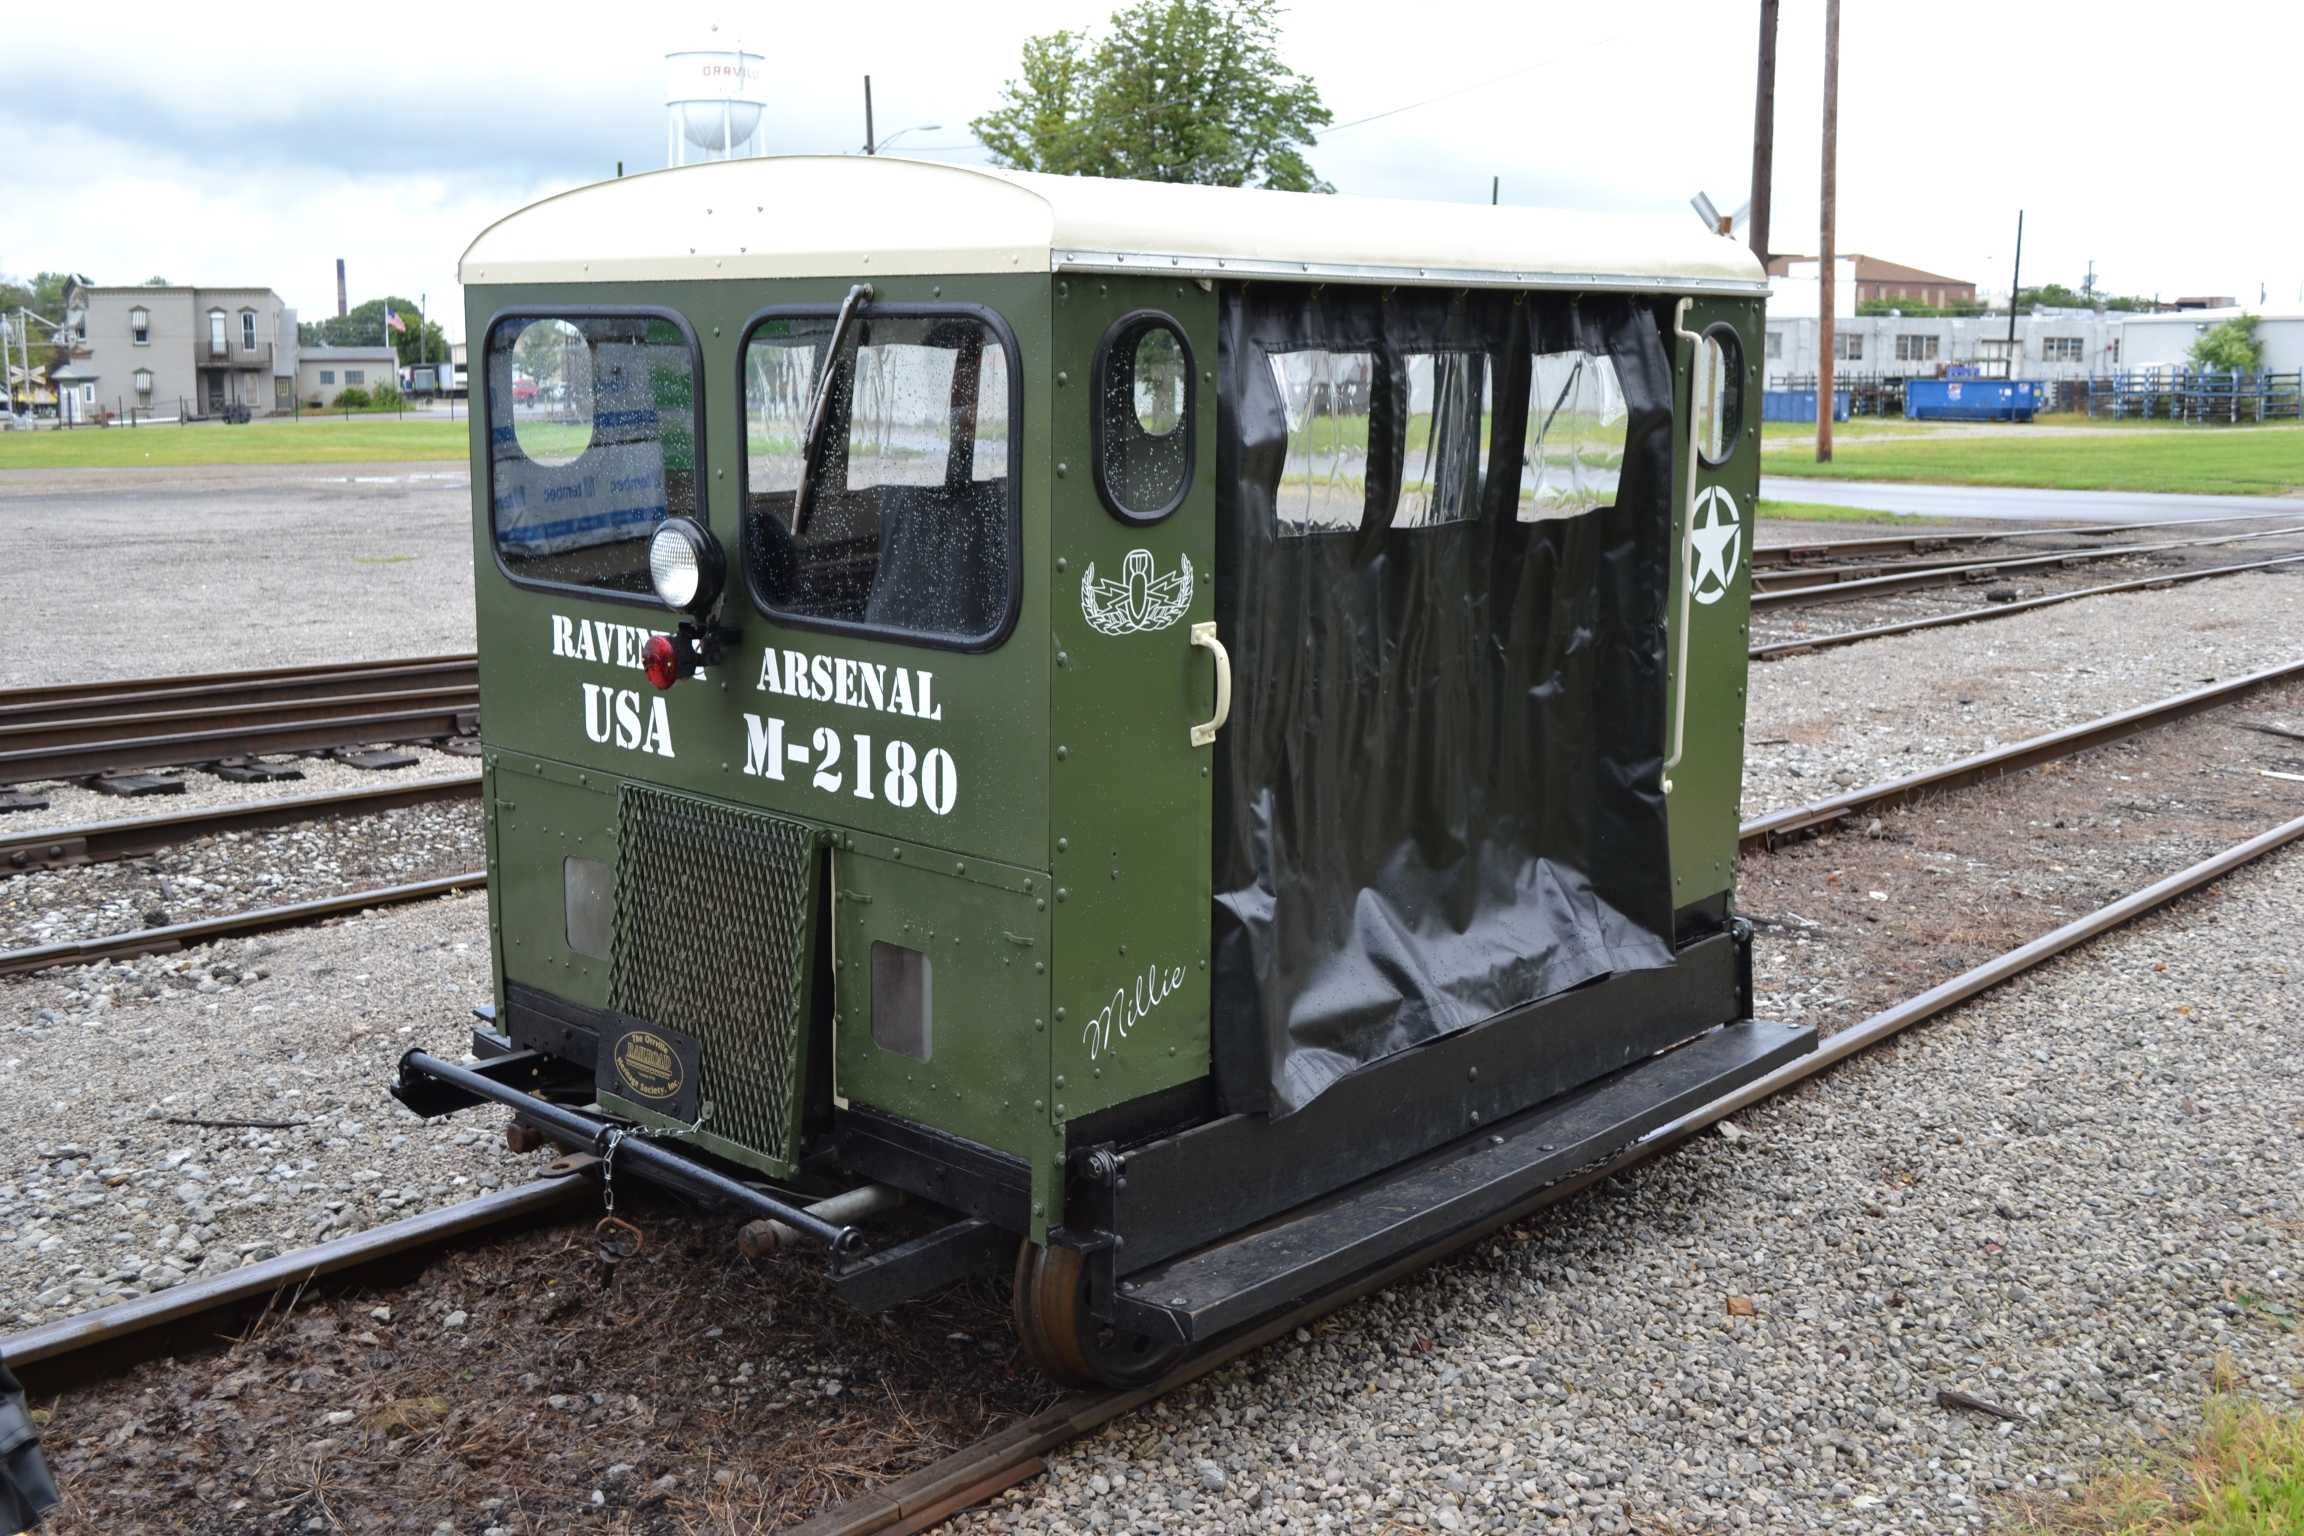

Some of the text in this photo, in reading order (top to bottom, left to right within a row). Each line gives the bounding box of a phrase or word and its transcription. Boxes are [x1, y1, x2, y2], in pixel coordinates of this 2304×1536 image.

[552, 615, 941, 721] RAVEN ARSENAL
[582, 683, 957, 816] USA M-2180
[632, 1034, 643, 1044] The
[1082, 964, 1186, 1060] Millie
